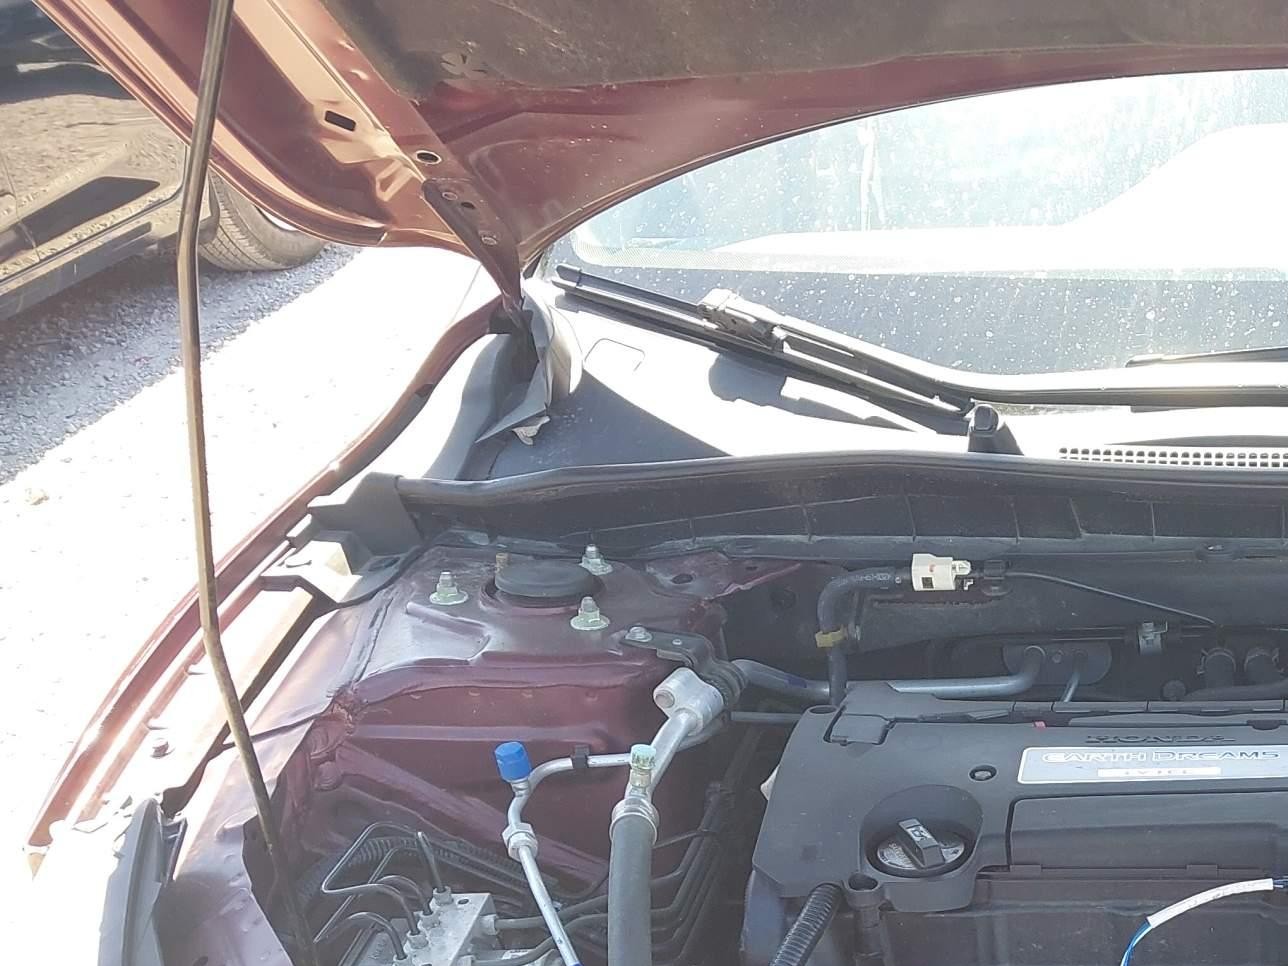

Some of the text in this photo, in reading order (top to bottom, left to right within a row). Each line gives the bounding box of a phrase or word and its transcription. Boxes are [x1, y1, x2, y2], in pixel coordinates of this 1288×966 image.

[1086, 735, 1235, 744] HONDA
[1041, 750, 1280, 763] EARTH DREAMS
